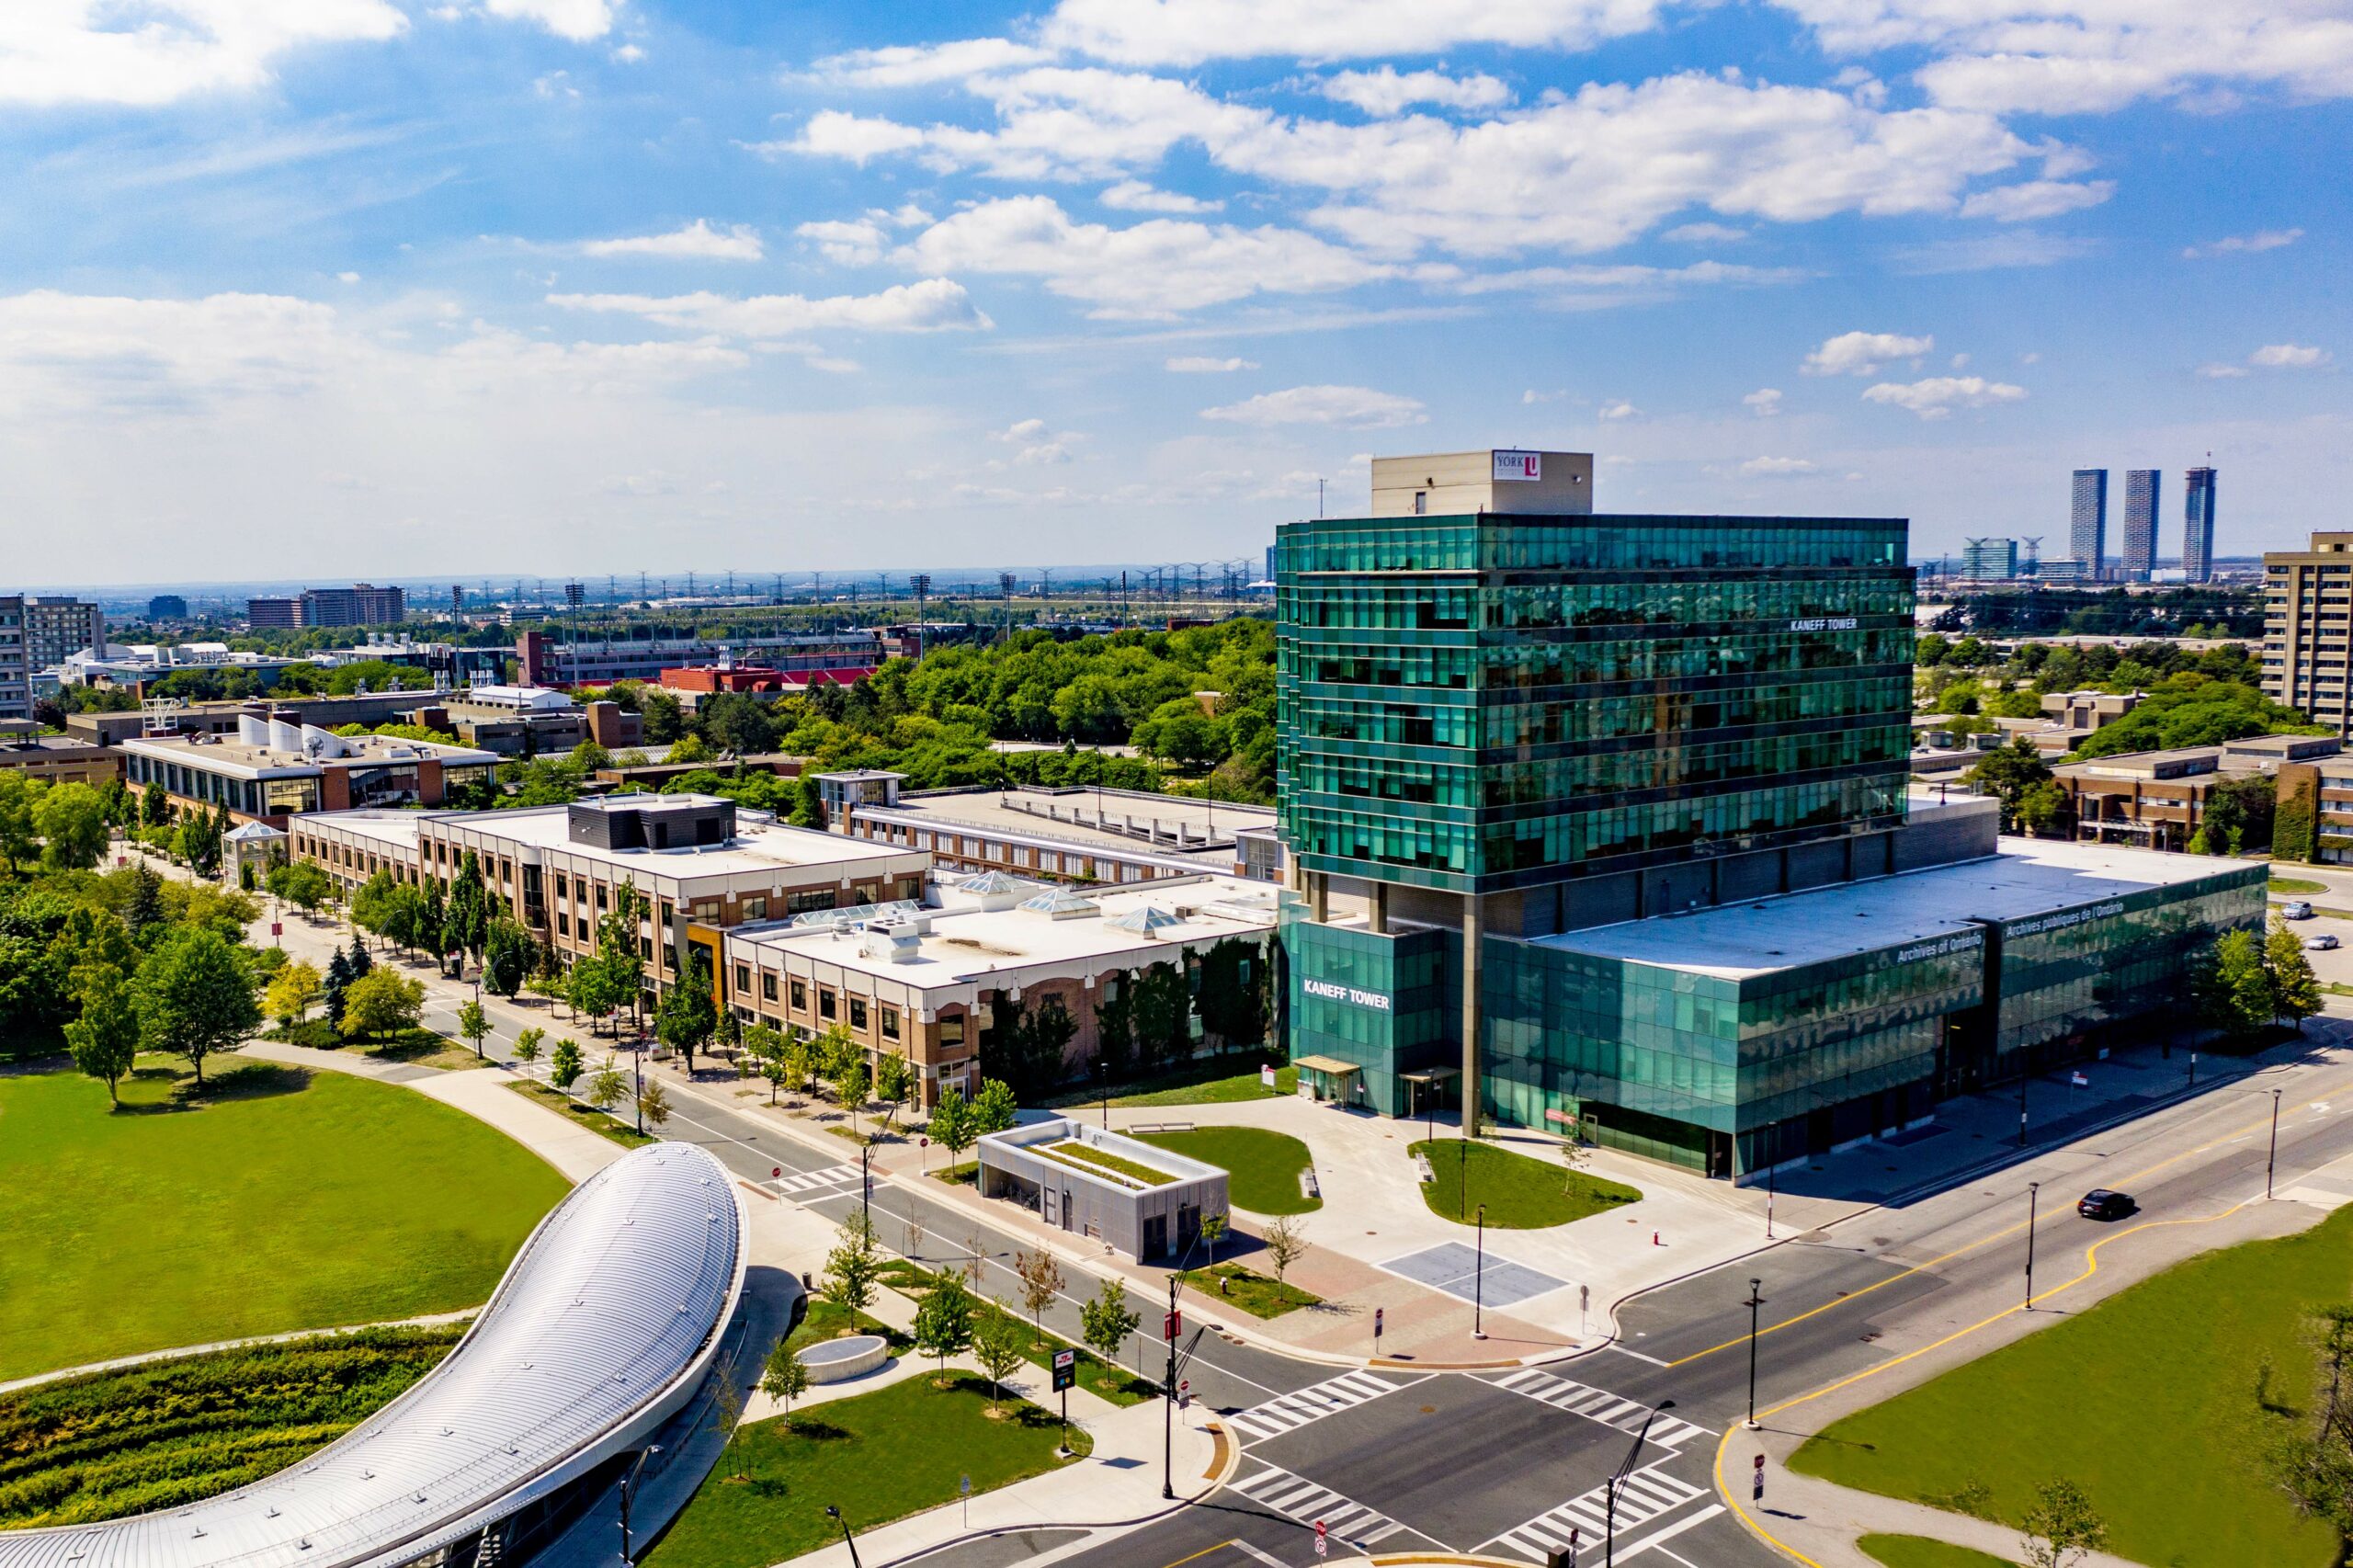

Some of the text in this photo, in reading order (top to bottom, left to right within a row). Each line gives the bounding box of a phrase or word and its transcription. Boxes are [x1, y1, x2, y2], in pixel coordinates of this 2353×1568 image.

[1497, 456, 1524, 467] YORK
[1790, 619, 1857, 631] KANEFF TOWER
[2006, 902, 2124, 937] Archives publiques de l'Ontario
[1897, 934, 1982, 963] Archives of Ontario
[1304, 979, 1389, 1009] KANEFF TOWER
